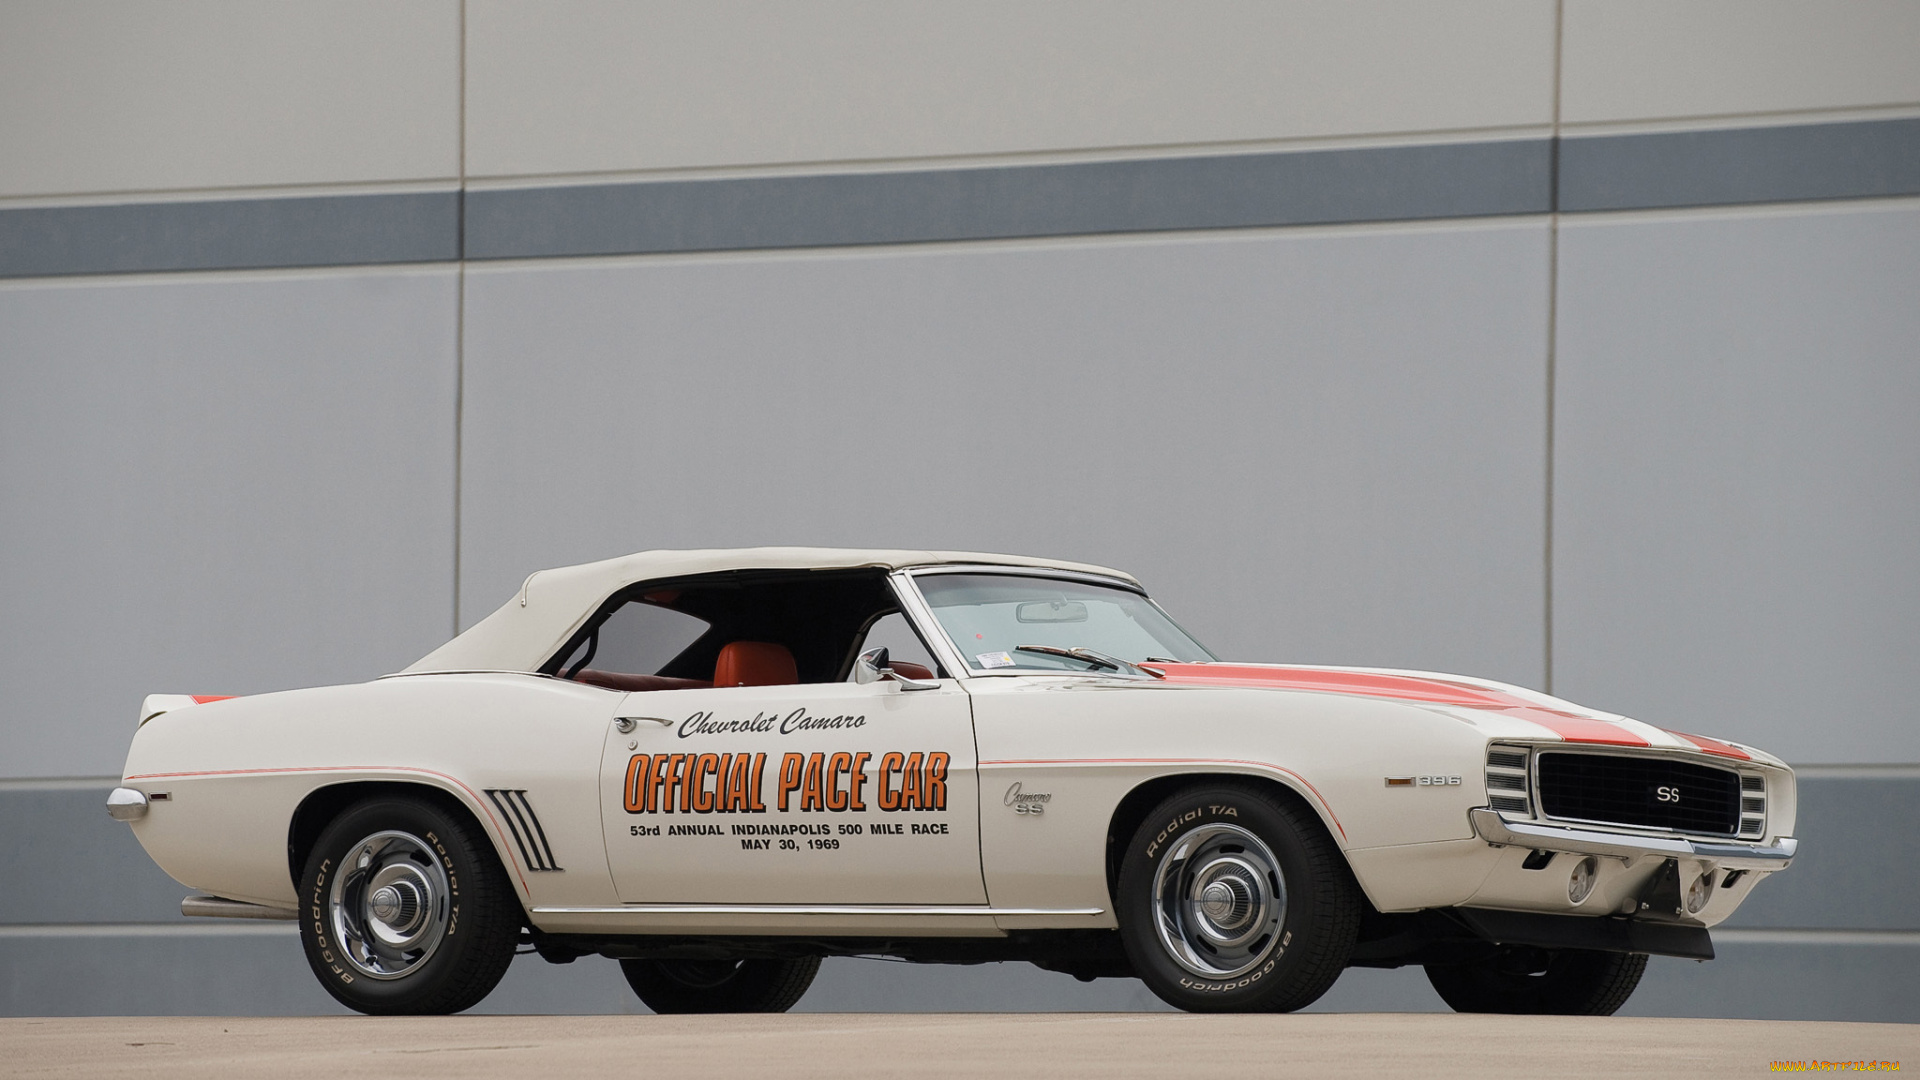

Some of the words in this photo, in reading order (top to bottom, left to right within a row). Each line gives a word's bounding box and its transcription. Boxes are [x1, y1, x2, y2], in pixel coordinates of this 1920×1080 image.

[677, 711, 778, 739] Chevrolet
[779, 707, 867, 736] Camaro
[623, 752, 767, 814] OFFICIAL
[777, 751, 873, 813] PACE
[877, 751, 952, 812] CAR
[1418, 775, 1462, 786] 396
[1656, 786, 1680, 803] SS
[1015, 803, 1045, 816] SS
[630, 825, 661, 836] 53rd
[667, 825, 725, 836] ANNUAL
[731, 824, 831, 836] INDIANAPOLIS
[838, 824, 863, 835] 500
[869, 824, 904, 835] MILE
[910, 823, 949, 835] RACE
[741, 839, 771, 850] MAY
[778, 839, 800, 852] 30,
[806, 839, 840, 850] 1969
[1146, 807, 1203, 859] Radial
[1208, 804, 1239, 818] T/A
[426, 831, 460, 896] Radial
[448, 903, 460, 936] T/A
[311, 858, 356, 985] BFGoodrich
[1179, 931, 1293, 994] BFGoodrich
